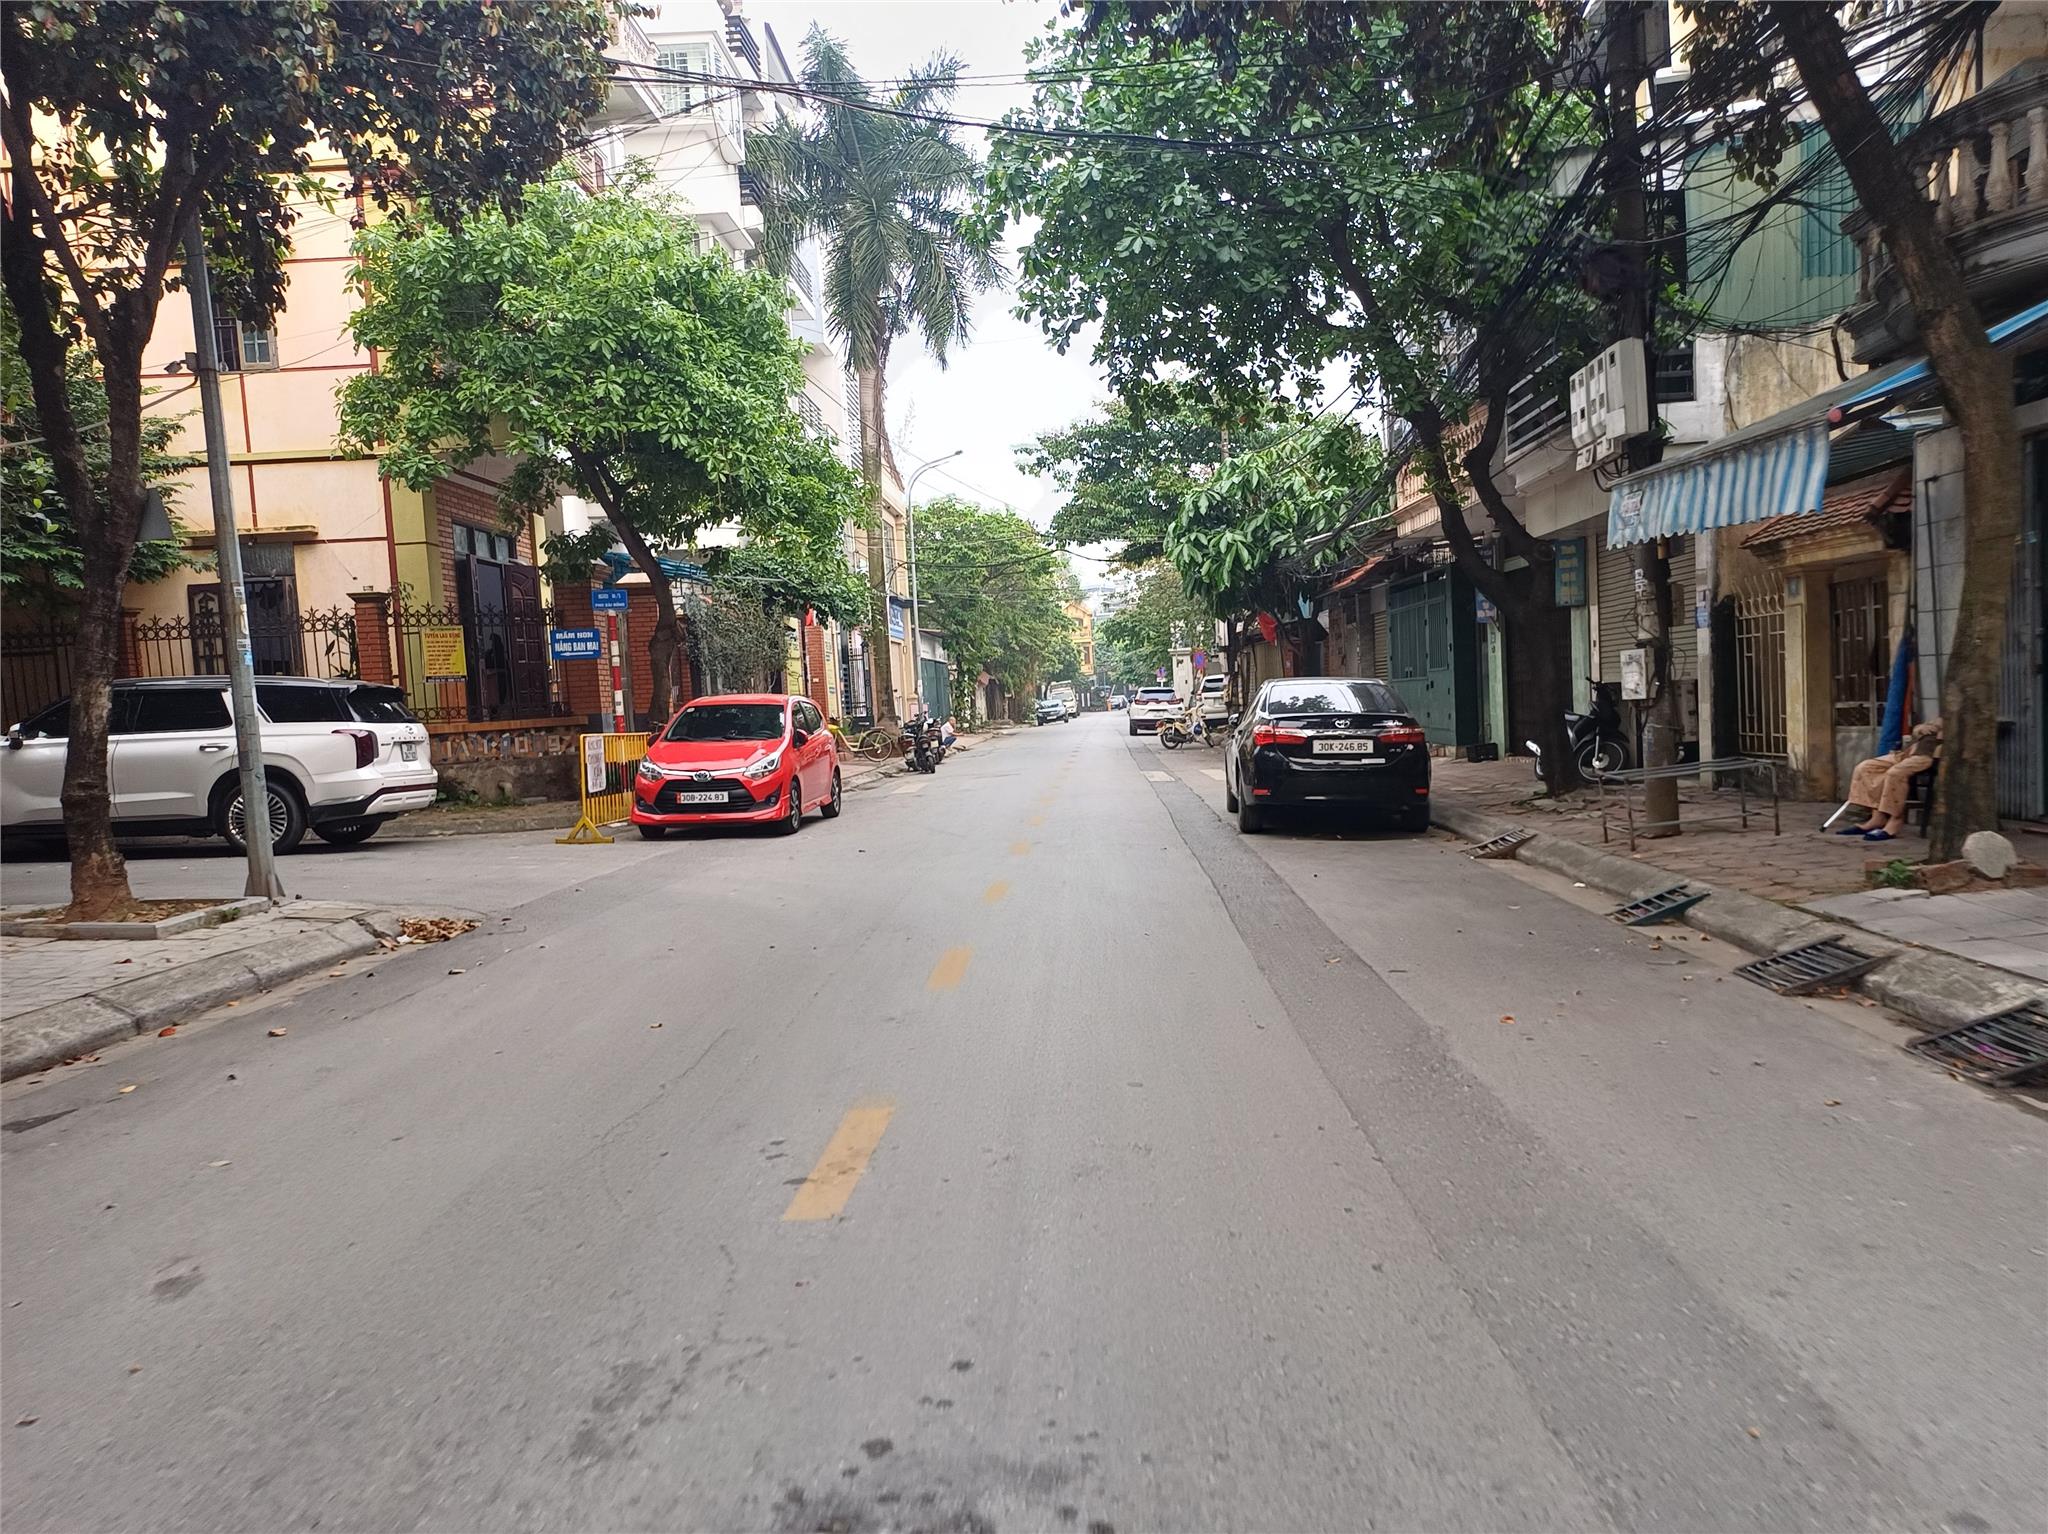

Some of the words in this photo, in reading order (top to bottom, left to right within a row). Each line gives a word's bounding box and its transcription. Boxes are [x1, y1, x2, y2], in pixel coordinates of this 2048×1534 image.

[573, 641, 586, 651] BAN
[587, 641, 599, 651] MAI
[1318, 742, 1369, 752] 30K-246.85
[681, 793, 725, 802] 30B-224.83
